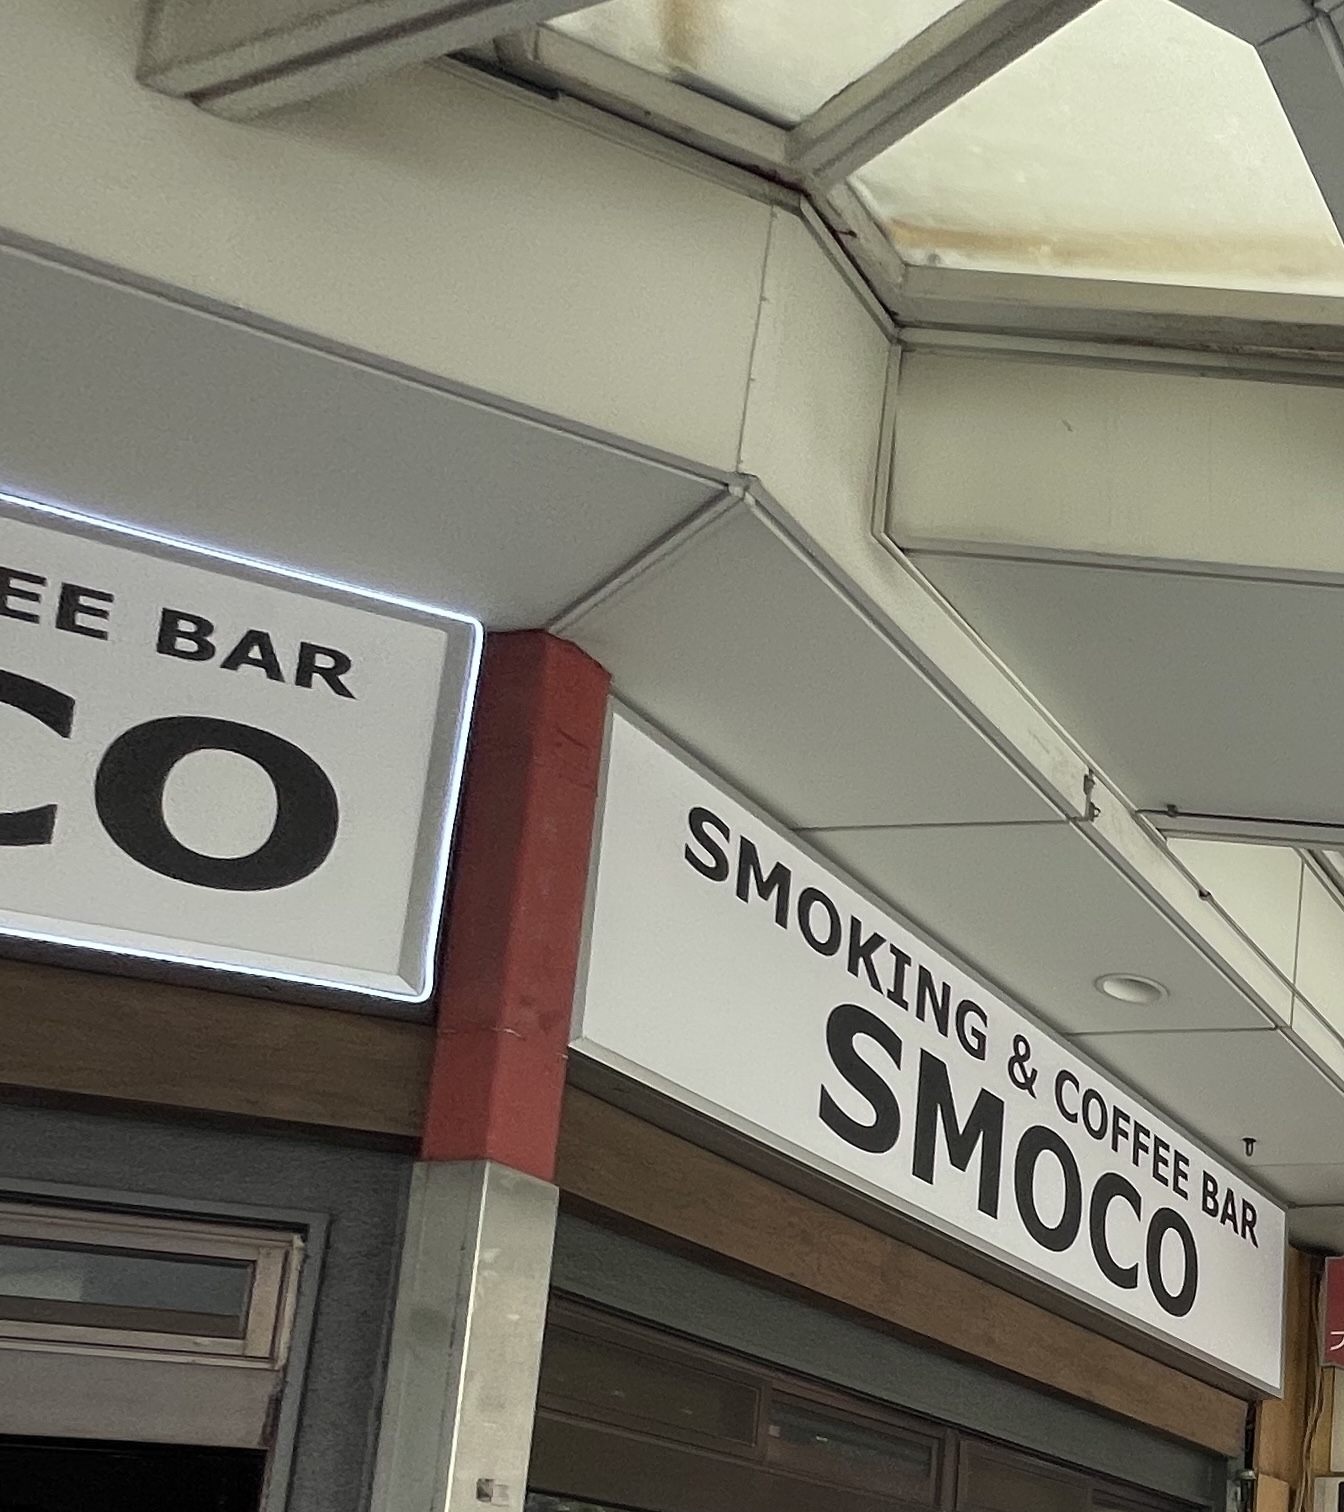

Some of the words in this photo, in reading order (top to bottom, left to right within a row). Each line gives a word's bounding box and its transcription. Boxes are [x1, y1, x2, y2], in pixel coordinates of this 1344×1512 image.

[156, 607, 357, 700] BAR
[684, 806, 989, 1061] SMOKING
[1007, 1034, 1038, 1099] &
[1054, 1069, 1190, 1201] COFFEE
[1201, 1172, 1260, 1248] BAR
[818, 1003, 1199, 1318] SMOCO
